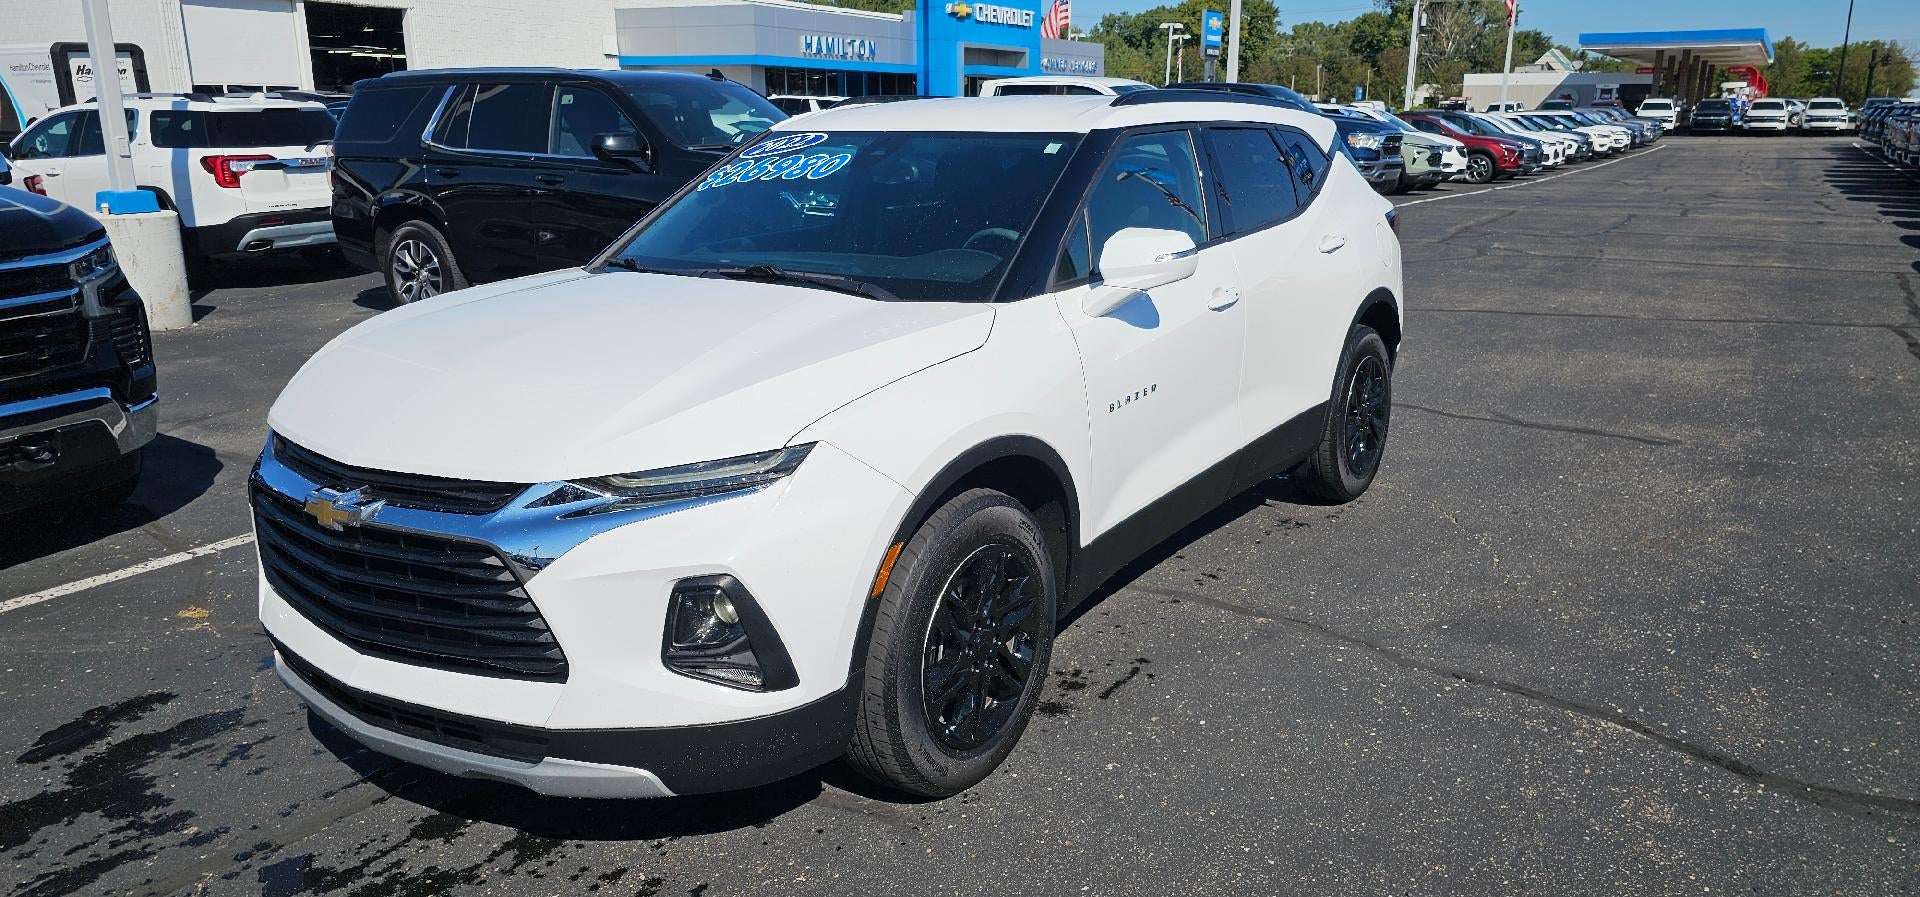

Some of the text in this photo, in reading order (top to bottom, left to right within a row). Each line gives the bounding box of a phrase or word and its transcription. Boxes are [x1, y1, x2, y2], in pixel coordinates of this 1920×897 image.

[975, 3, 1035, 27] CHEVROLET
[803, 35, 876, 57] HAMILTON
[697, 154, 852, 191] $26980
[1108, 383, 1157, 413] BLAZER
